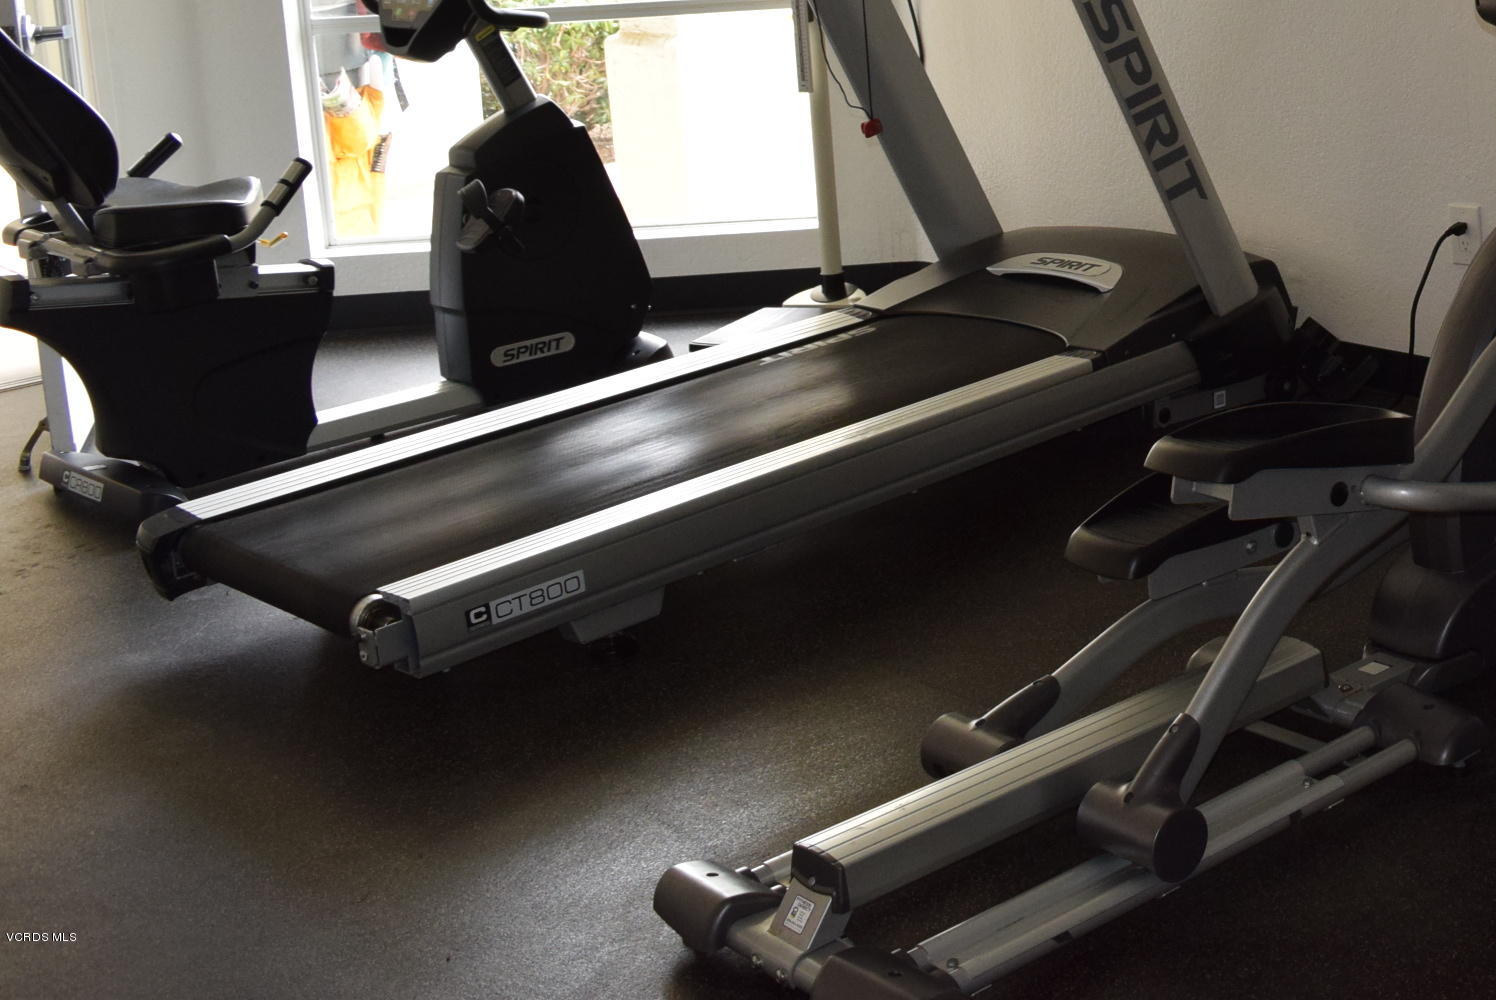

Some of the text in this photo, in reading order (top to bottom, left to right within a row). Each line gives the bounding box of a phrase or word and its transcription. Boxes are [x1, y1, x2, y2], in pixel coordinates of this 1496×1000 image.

[1030, 256, 1103, 272] SPIRIT
[502, 336, 567, 364] SPIRIT
[469, 575, 581, 624] C CT800
